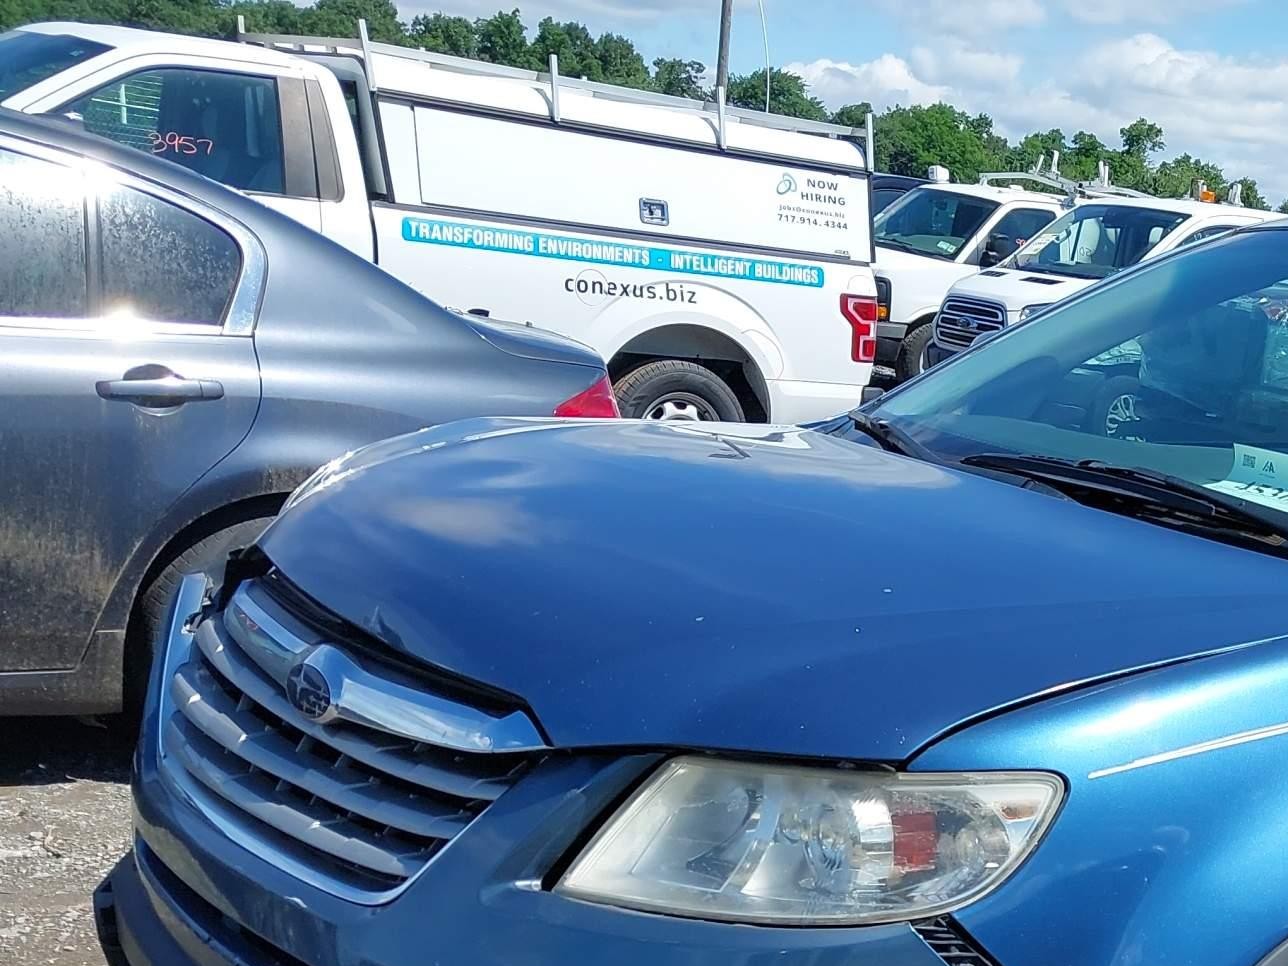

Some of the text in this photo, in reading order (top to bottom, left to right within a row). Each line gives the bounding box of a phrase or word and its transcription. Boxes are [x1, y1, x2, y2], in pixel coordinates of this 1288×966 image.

[148, 132, 213, 154] 3957
[806, 178, 838, 191] NOW
[800, 191, 846, 206] HIRING
[777, 213, 848, 230] 717.914.4344
[408, 220, 534, 252] TRANSFORMING
[538, 238, 649, 266] ENVIRONMENTS
[670, 252, 752, 277] INTELLIGENT
[754, 263, 820, 284] BUILDINGS
[564, 277, 698, 304] conexus.biz
